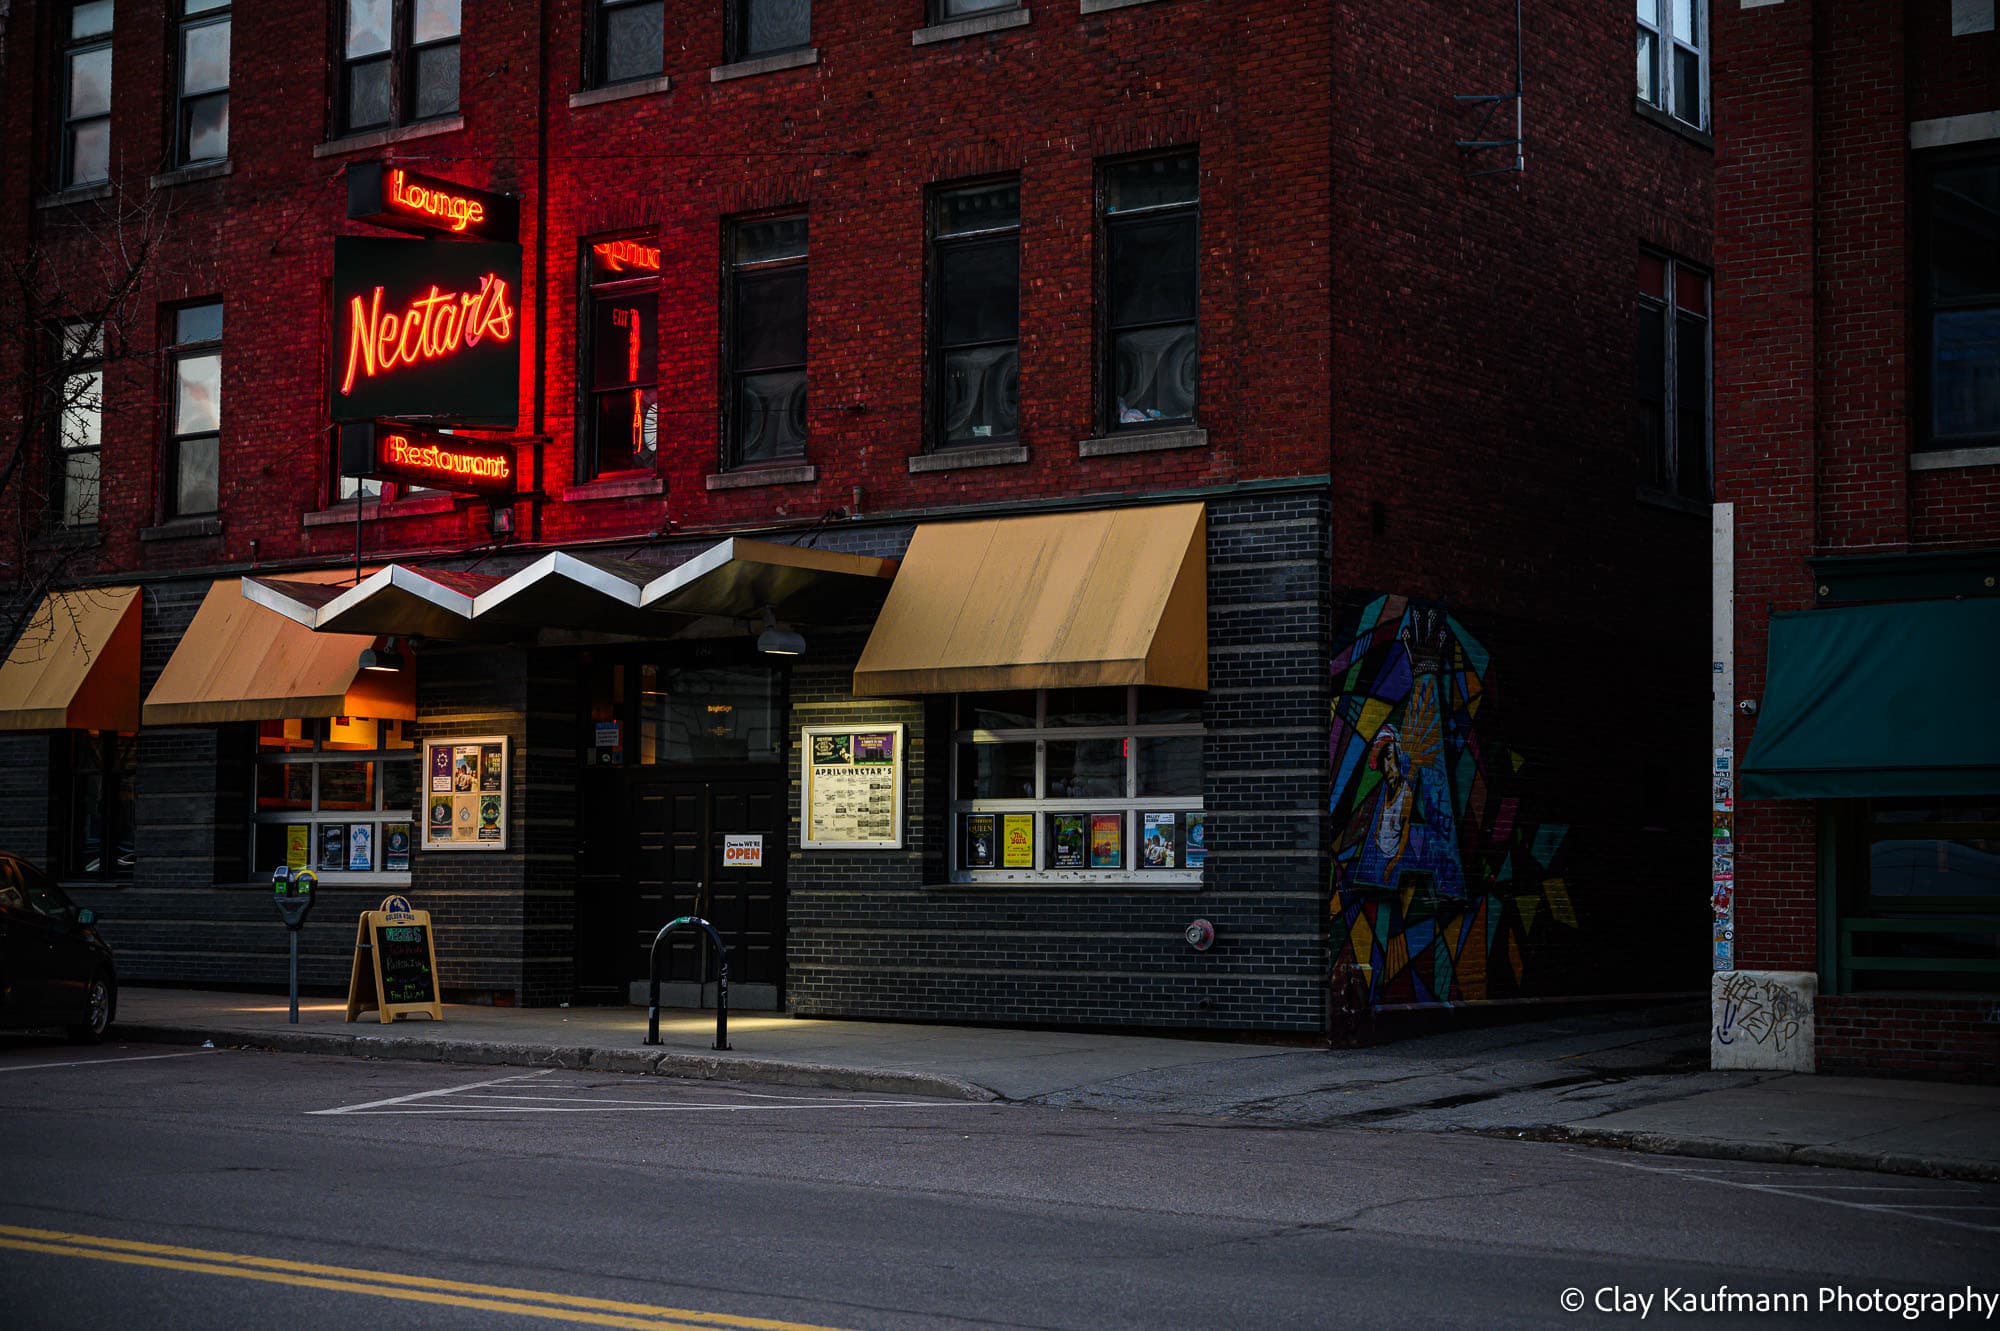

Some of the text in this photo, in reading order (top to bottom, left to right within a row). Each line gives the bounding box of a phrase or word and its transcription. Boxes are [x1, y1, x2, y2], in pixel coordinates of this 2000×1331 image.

[393, 168, 484, 231] Lounge
[341, 272, 513, 396] Nectar's
[385, 435, 509, 479] Restaurant
[726, 848, 760, 860] OPEN
